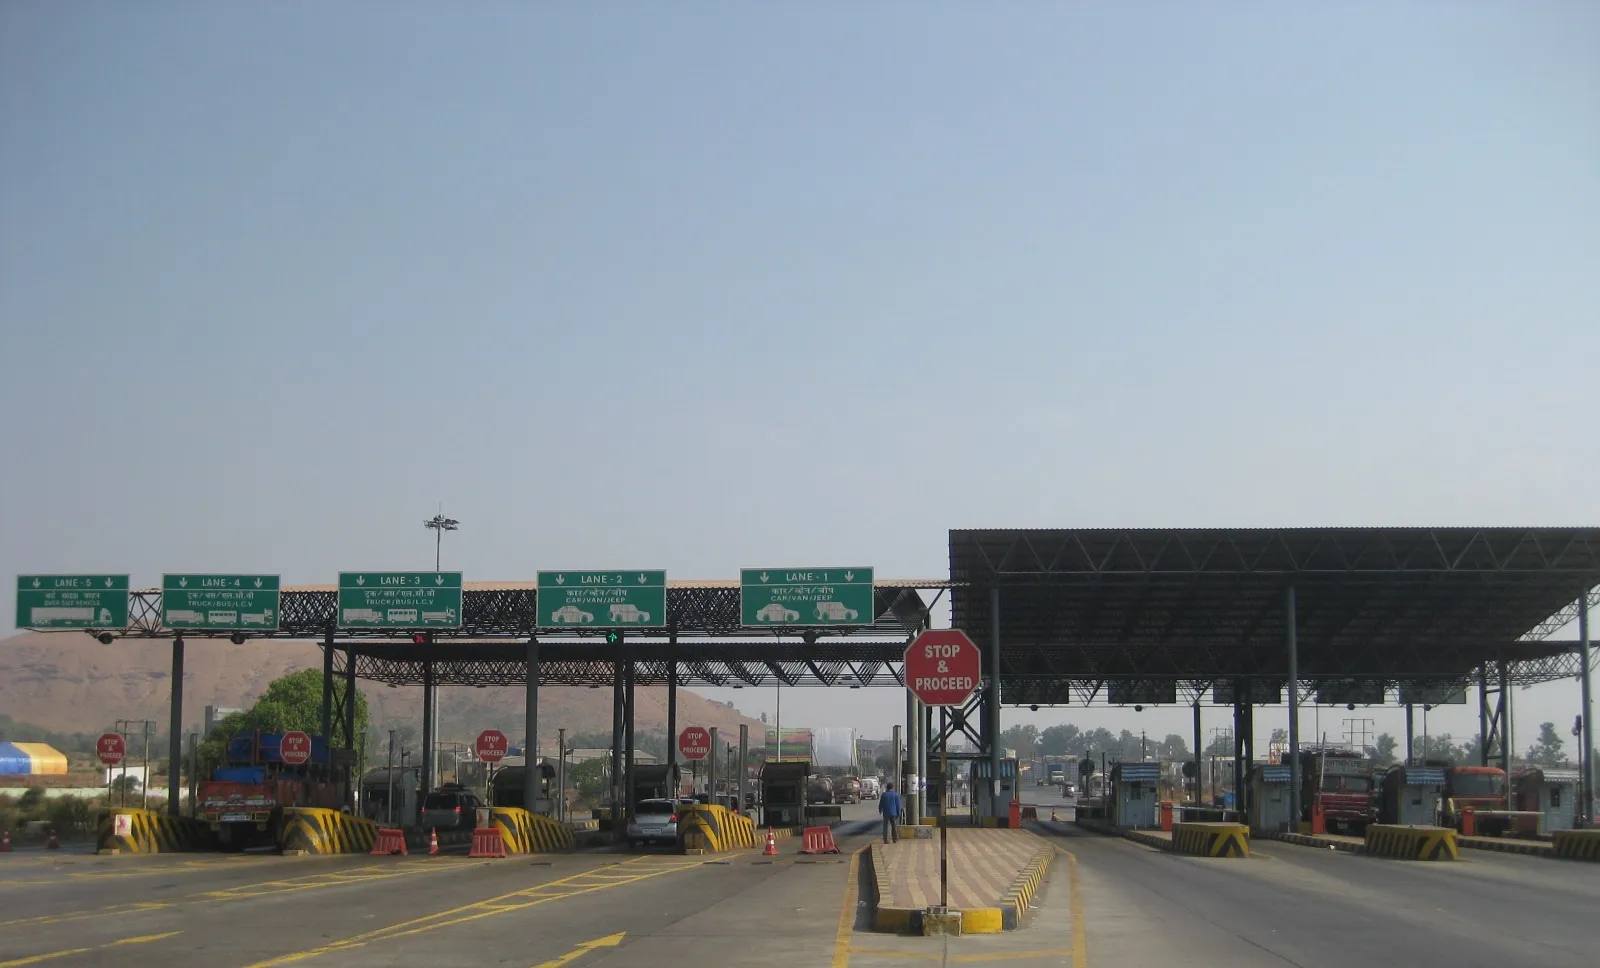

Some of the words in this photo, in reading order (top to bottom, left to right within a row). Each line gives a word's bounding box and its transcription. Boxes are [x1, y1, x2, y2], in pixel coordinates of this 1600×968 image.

[380, 576, 405, 584] LANE
[414, 576, 420, 584] 3
[581, 575, 607, 583] LANE
[617, 575, 622, 583] 2
[786, 572, 813, 581] LANE
[824, 572, 828, 581] 1
[55, 579, 78, 587] LANE
[86, 579, 91, 587] 5
[202, 579, 226, 587] LANE
[234, 579, 240, 587] 4
[925, 645, 960, 658] STOP
[937, 660, 949, 673] &
[915, 677, 972, 690] PROCEED
